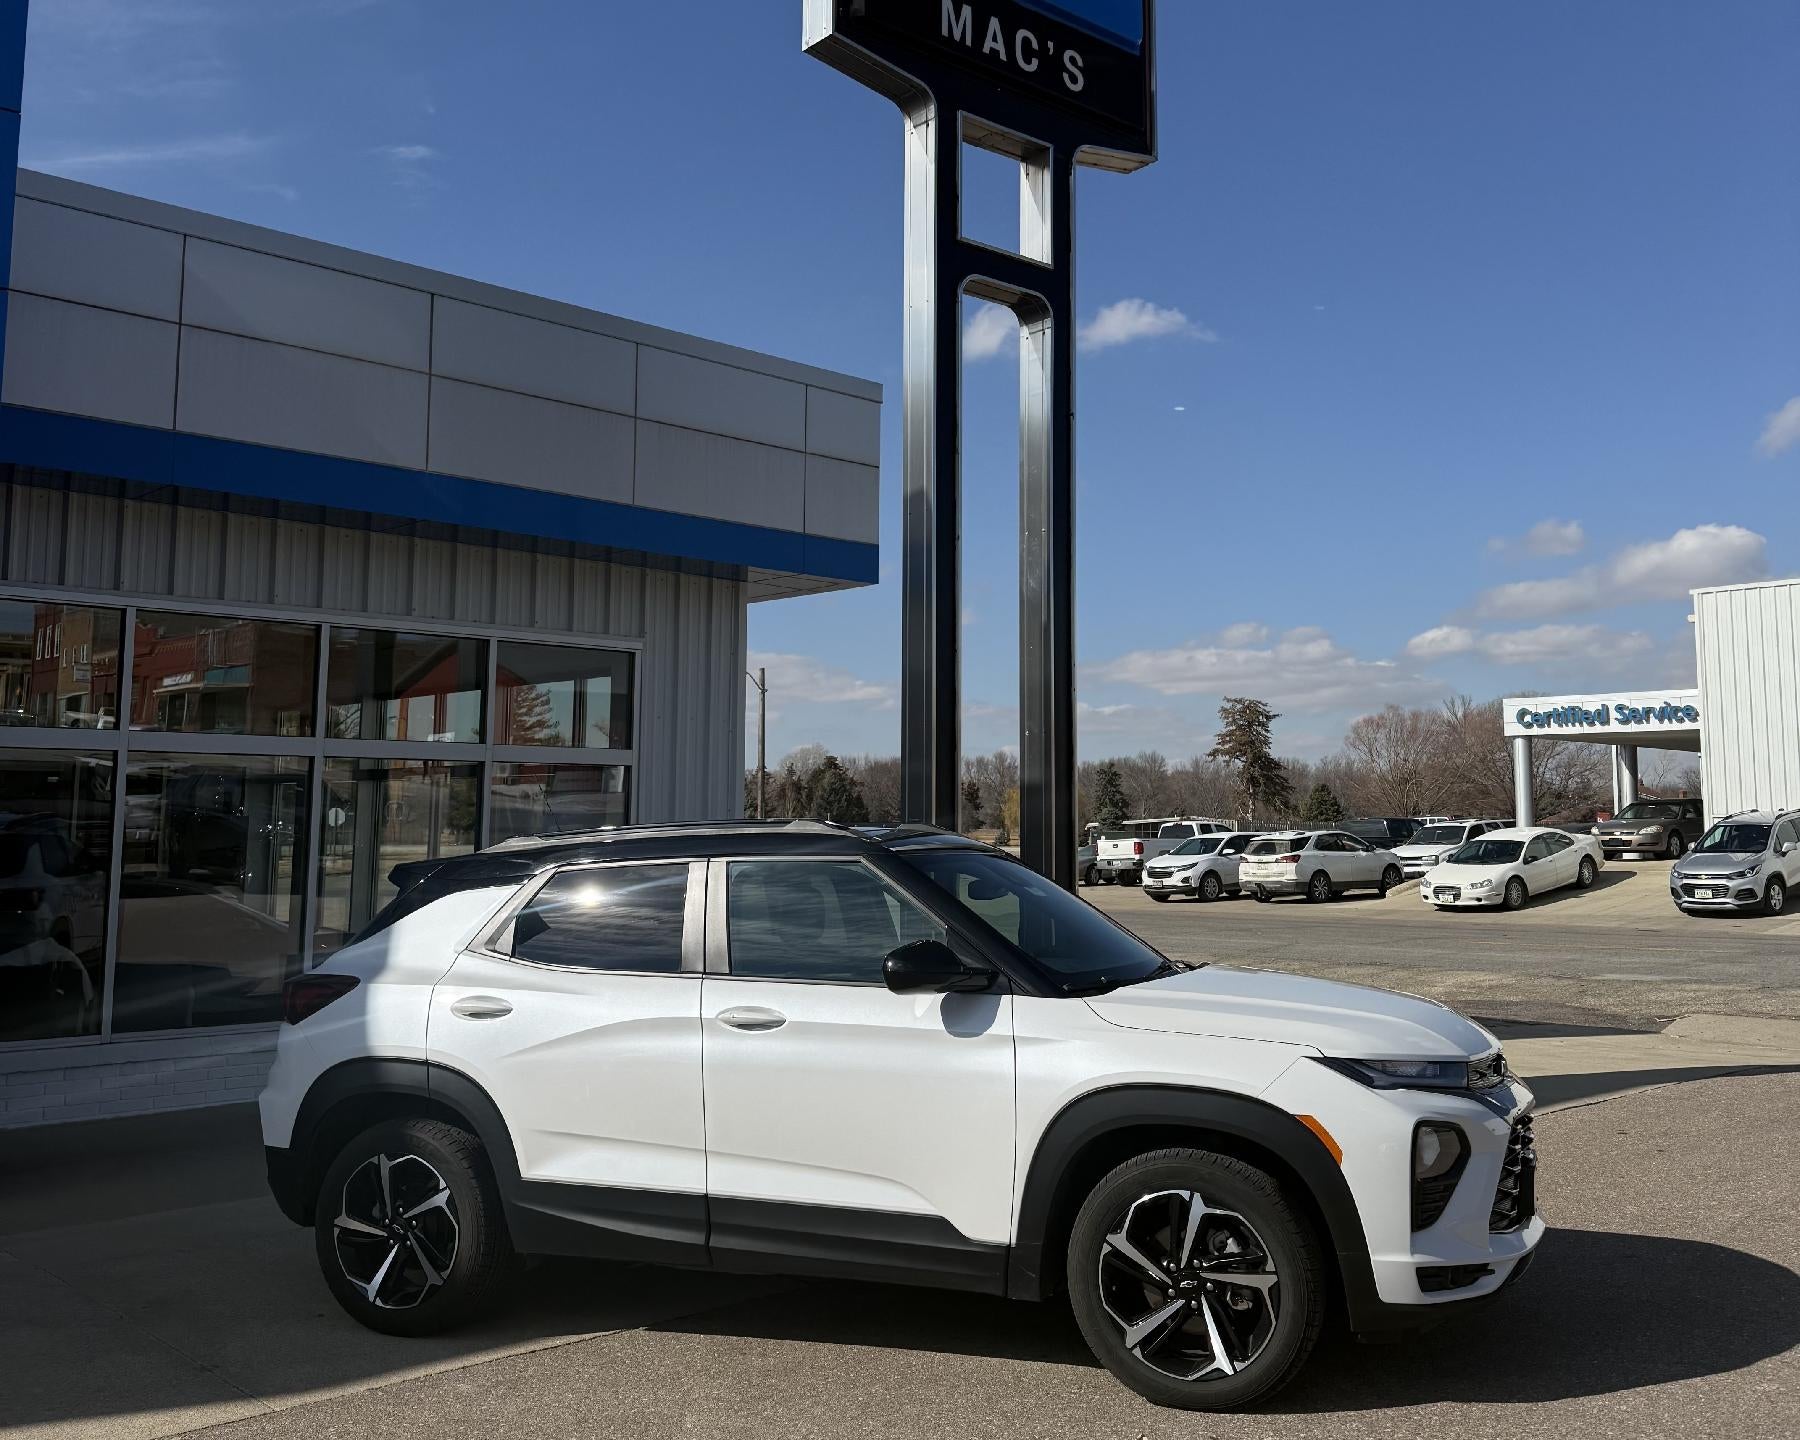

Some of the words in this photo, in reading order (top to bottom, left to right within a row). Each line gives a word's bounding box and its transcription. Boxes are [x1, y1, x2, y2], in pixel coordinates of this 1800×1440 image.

[941, 0, 1085, 92] MAC'S
[1516, 703, 1610, 729] Certified
[1614, 701, 1699, 725] Service
